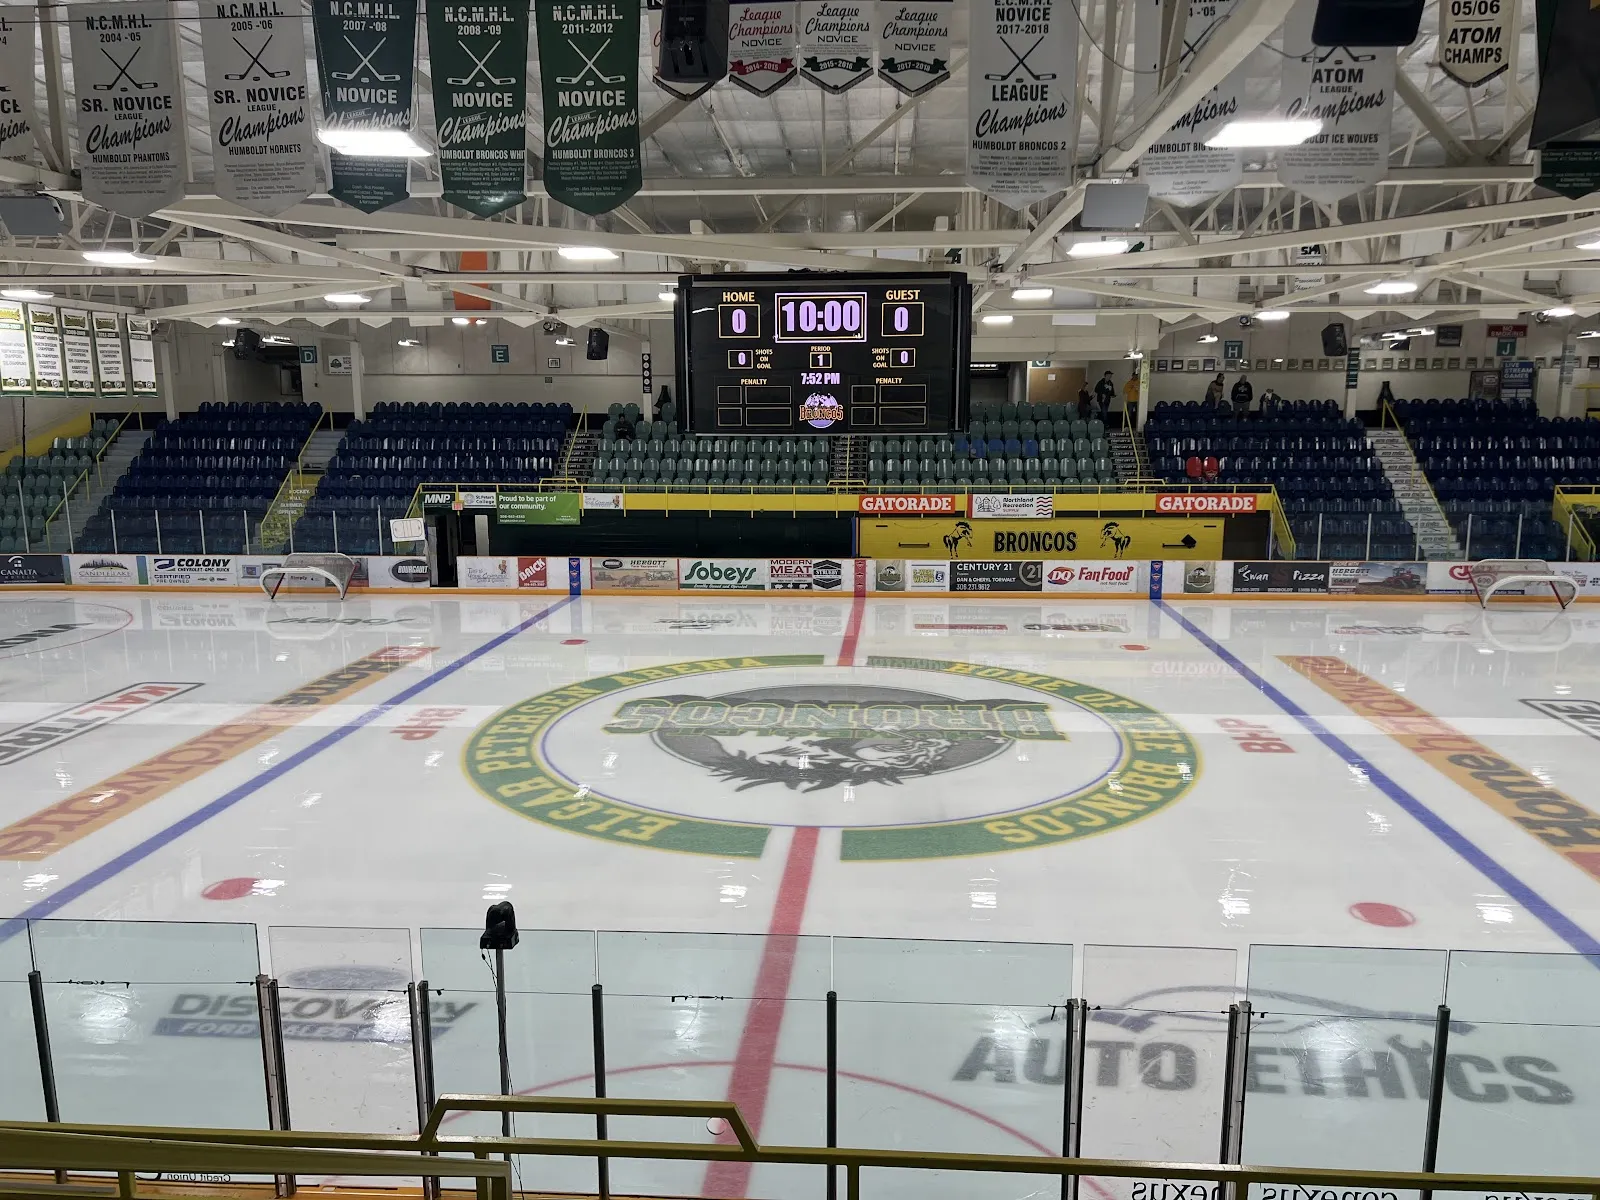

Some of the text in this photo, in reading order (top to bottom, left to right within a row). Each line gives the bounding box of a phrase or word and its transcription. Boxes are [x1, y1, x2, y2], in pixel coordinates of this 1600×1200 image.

[217, 2, 284, 18] N.C.M.H.L.
[330, 1, 400, 20] N.C.M.H.L.
[444, 6, 514, 22] N.C.M.H.L.
[553, 4, 623, 21] N.C.M.H.L.
[740, 8, 782, 24] League
[817, 3, 860, 20] League
[996, 8, 1050, 21] NOVICE
[1452, 0, 1500, 16] 05/06
[86, 15, 152, 31] N.C.M.H.L.
[895, 8, 938, 25] League
[231, 20, 252, 31] 2005
[343, 21, 366, 31] 2007
[458, 24, 480, 35] 2008
[562, 23, 613, 34] 2011-2012
[729, 21, 792, 40] Champions
[806, 18, 870, 35] Champions
[883, 22, 948, 40] Champions
[997, 24, 1048, 34] 2017-2018
[100, 33, 121, 43] 2004
[742, 38, 782, 47] NOVICE
[1448, 26, 1501, 44] ATOM
[1444, 46, 1502, 64] CHAMPS
[1312, 68, 1364, 84] ATOM
[214, 86, 305, 104] SR. NOVICE
[336, 88, 398, 104] NOVICE
[992, 84, 1048, 101] LEAGUE
[1320, 85, 1352, 93] LEAGUE
[81, 95, 172, 112] SR. NOVICE
[452, 92, 513, 108] NOVICE
[558, 90, 626, 107] NOVICE
[247, 104, 277, 112] LEAGUE
[1286, 89, 1386, 126] Champions
[218, 106, 306, 147] Champions
[976, 102, 1068, 138] Champions
[86, 115, 172, 154] Champions
[438, 110, 526, 148] Champions
[547, 109, 636, 148] Champions
[972, 140, 1066, 150] HUMBOLDT BRONCOS 2
[1332, 133, 1378, 144] ICE WOLVES
[228, 144, 302, 156] HUMBOLDT HORNETS
[476, 150, 508, 159] BRONCOS
[552, 148, 634, 160] HUMBOLDT BRONCOS 3
[1148, 142, 1190, 154] HUMBOLDT
[92, 152, 170, 164] HUMBOLDT PHANTOMS
[722, 292, 755, 302] HOME
[885, 290, 920, 300] GUEST
[732, 309, 746, 333] 0
[782, 300, 860, 332] 10:00
[894, 307, 909, 332] 0
[304, 352, 314, 362] D
[496, 351, 504, 362] E
[1228, 346, 1238, 358] H
[1502, 344, 1510, 354] J
[738, 353, 746, 365] 0
[817, 355, 824, 366] 1
[900, 351, 909, 364] 0
[800, 373, 840, 385] 7:52 PM
[800, 405, 844, 422] BRONCOS
[424, 494, 450, 503] MNP
[862, 497, 952, 511] GATORADE
[1160, 496, 1254, 511] GATORADE
[994, 530, 1078, 553] BRONCOS
[518, 558, 546, 581] BRICK
[684, 561, 756, 584] Sobeys
[1026, 564, 1042, 578] 21
[1051, 571, 1071, 580] DQ
[1242, 570, 1324, 581] Swan Pizza
[272, 660, 410, 707] Home
[72, 685, 181, 716] KAL
[600, 699, 1068, 742] BRONCOS
[476, 656, 768, 841] ELGAR PETERSEN ARENA
[944, 662, 1186, 846] HOME OF THE BRONCOS
[1446, 754, 1600, 848] Home
[179, 1022, 254, 1037] FORD
[953, 1030, 1579, 1107] AUTO ETHICS
